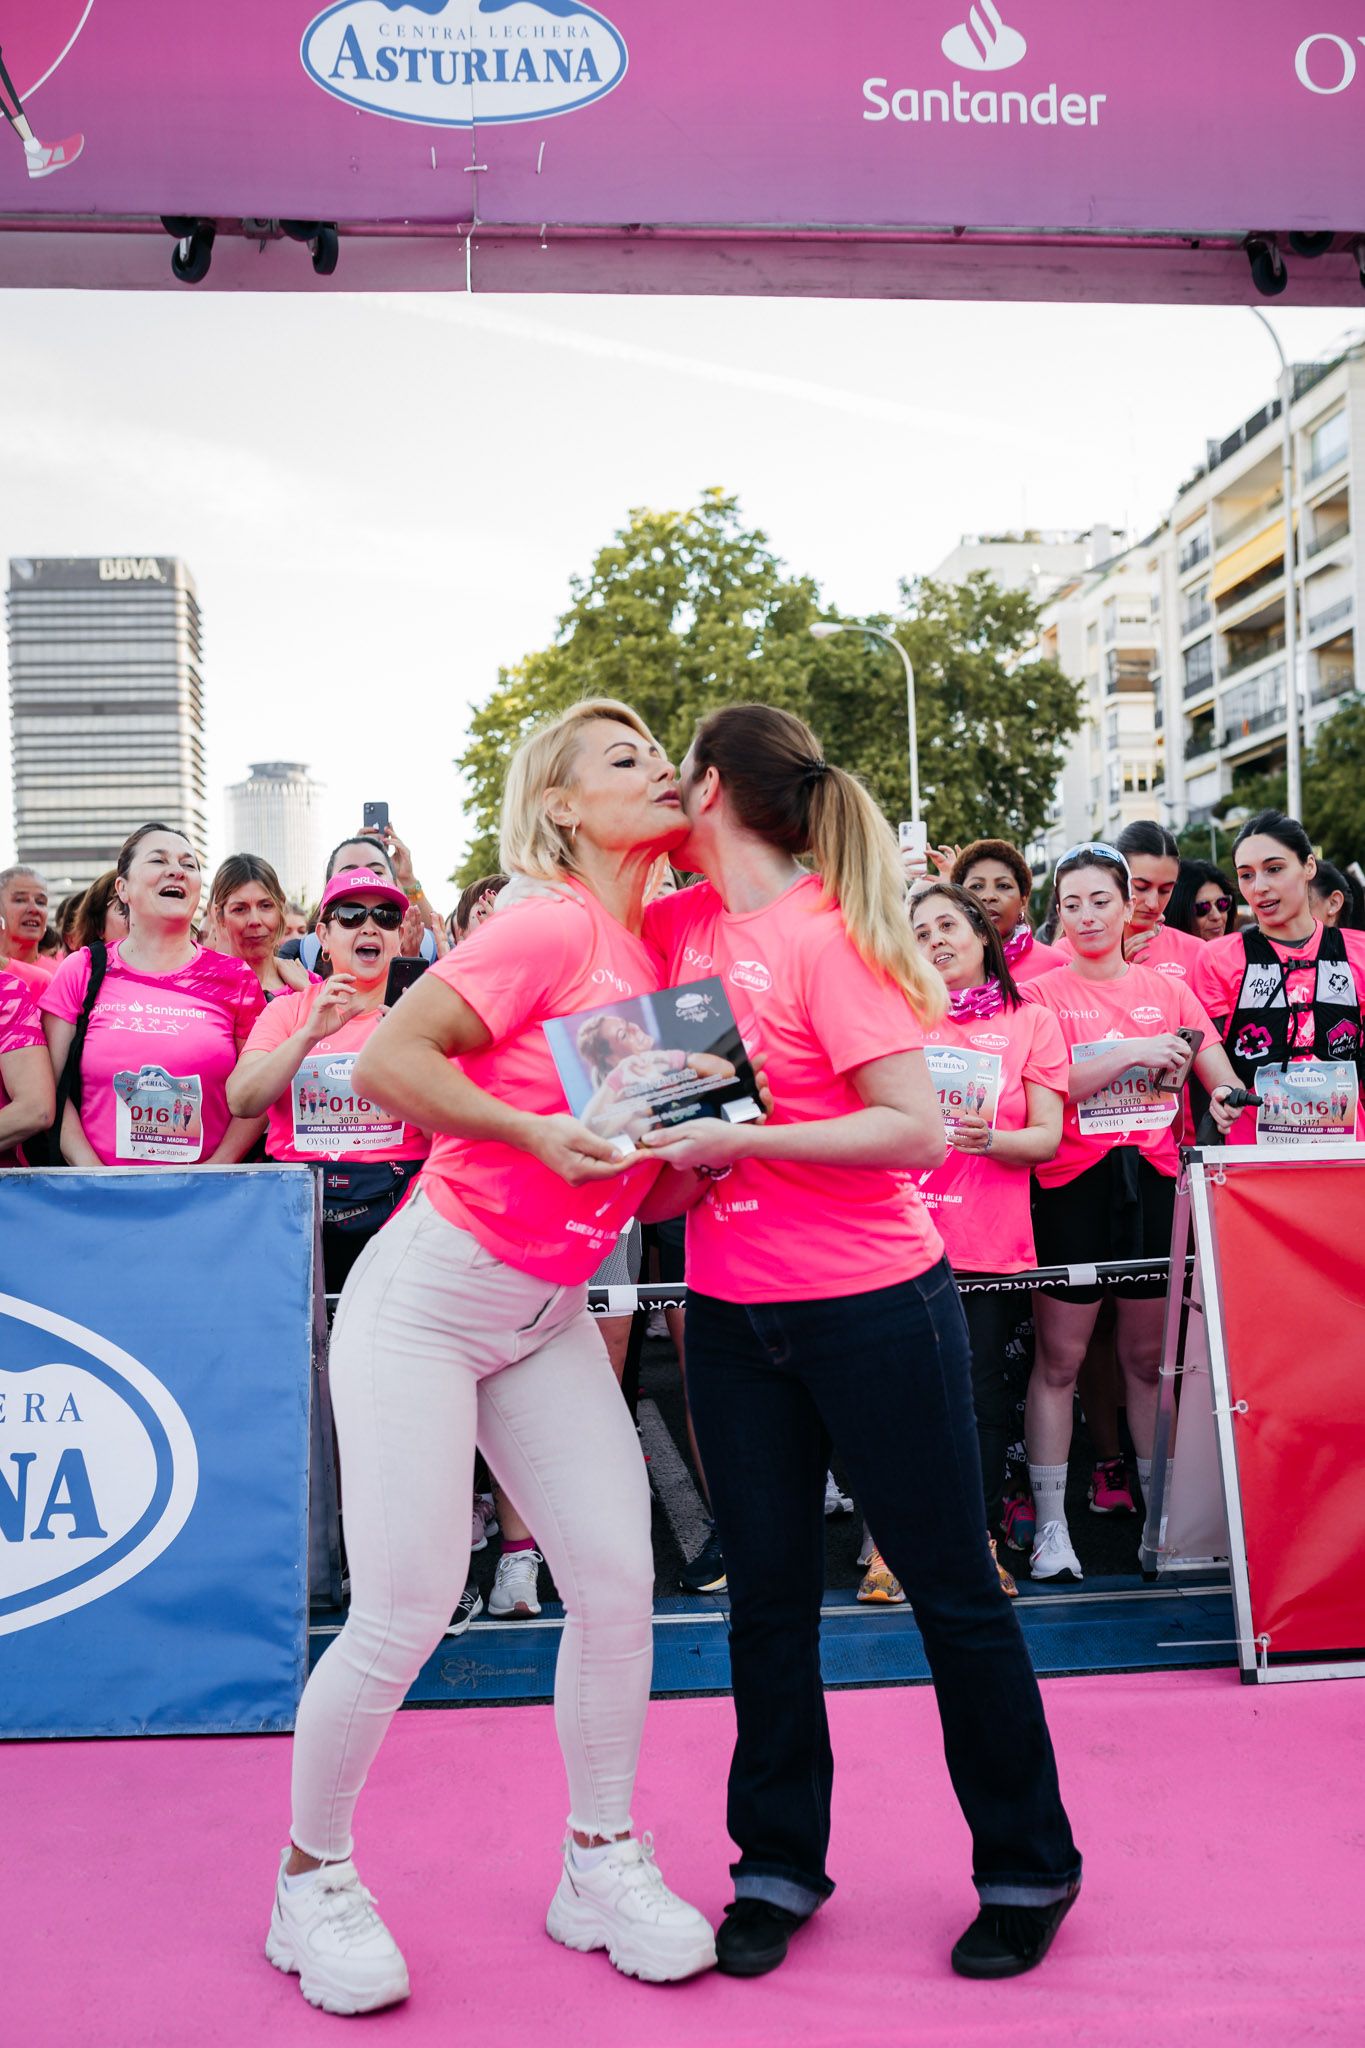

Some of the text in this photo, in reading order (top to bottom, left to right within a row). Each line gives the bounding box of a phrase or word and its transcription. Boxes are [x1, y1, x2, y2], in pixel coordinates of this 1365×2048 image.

[378, 23, 591, 40] CENTRAL LECHERA
[328, 24, 603, 86] ASTURIANA
[1294, 33, 1365, 95] O
[862, 78, 1106, 126] Santander
[99, 558, 162, 581] BBVA
[145, 1003, 207, 1019] Santander
[1060, 1009, 1099, 1019] OYSHO
[1111, 1078, 1147, 1095] 016
[937, 1088, 962, 1106] 16
[1119, 1098, 1141, 1106] 13170
[329, 1096, 371, 1113] 016
[1290, 1100, 1329, 1116] 016
[131, 1105, 170, 1123] 016
[1090, 1108, 1114, 1116] CARRERA
[339, 1116, 359, 1124] 3070
[135, 1125, 159, 1134] 10284
[1268, 1125, 1292, 1133] CARRERA
[1308, 1126, 1324, 1134] MUJER
[145, 1135, 163, 1143] MUJER
[167, 1136, 189, 1144] MADRID
[306, 1136, 393, 1146] OYSHO Santander
[1266, 1135, 1300, 1144] OYSHO
[156, 1148, 189, 1157] Santander
[926, 1192, 935, 1200] DE
[935, 1193, 943, 1201] LA
[943, 1194, 963, 1203] MUJER
[731, 1199, 759, 1212] MUJER
